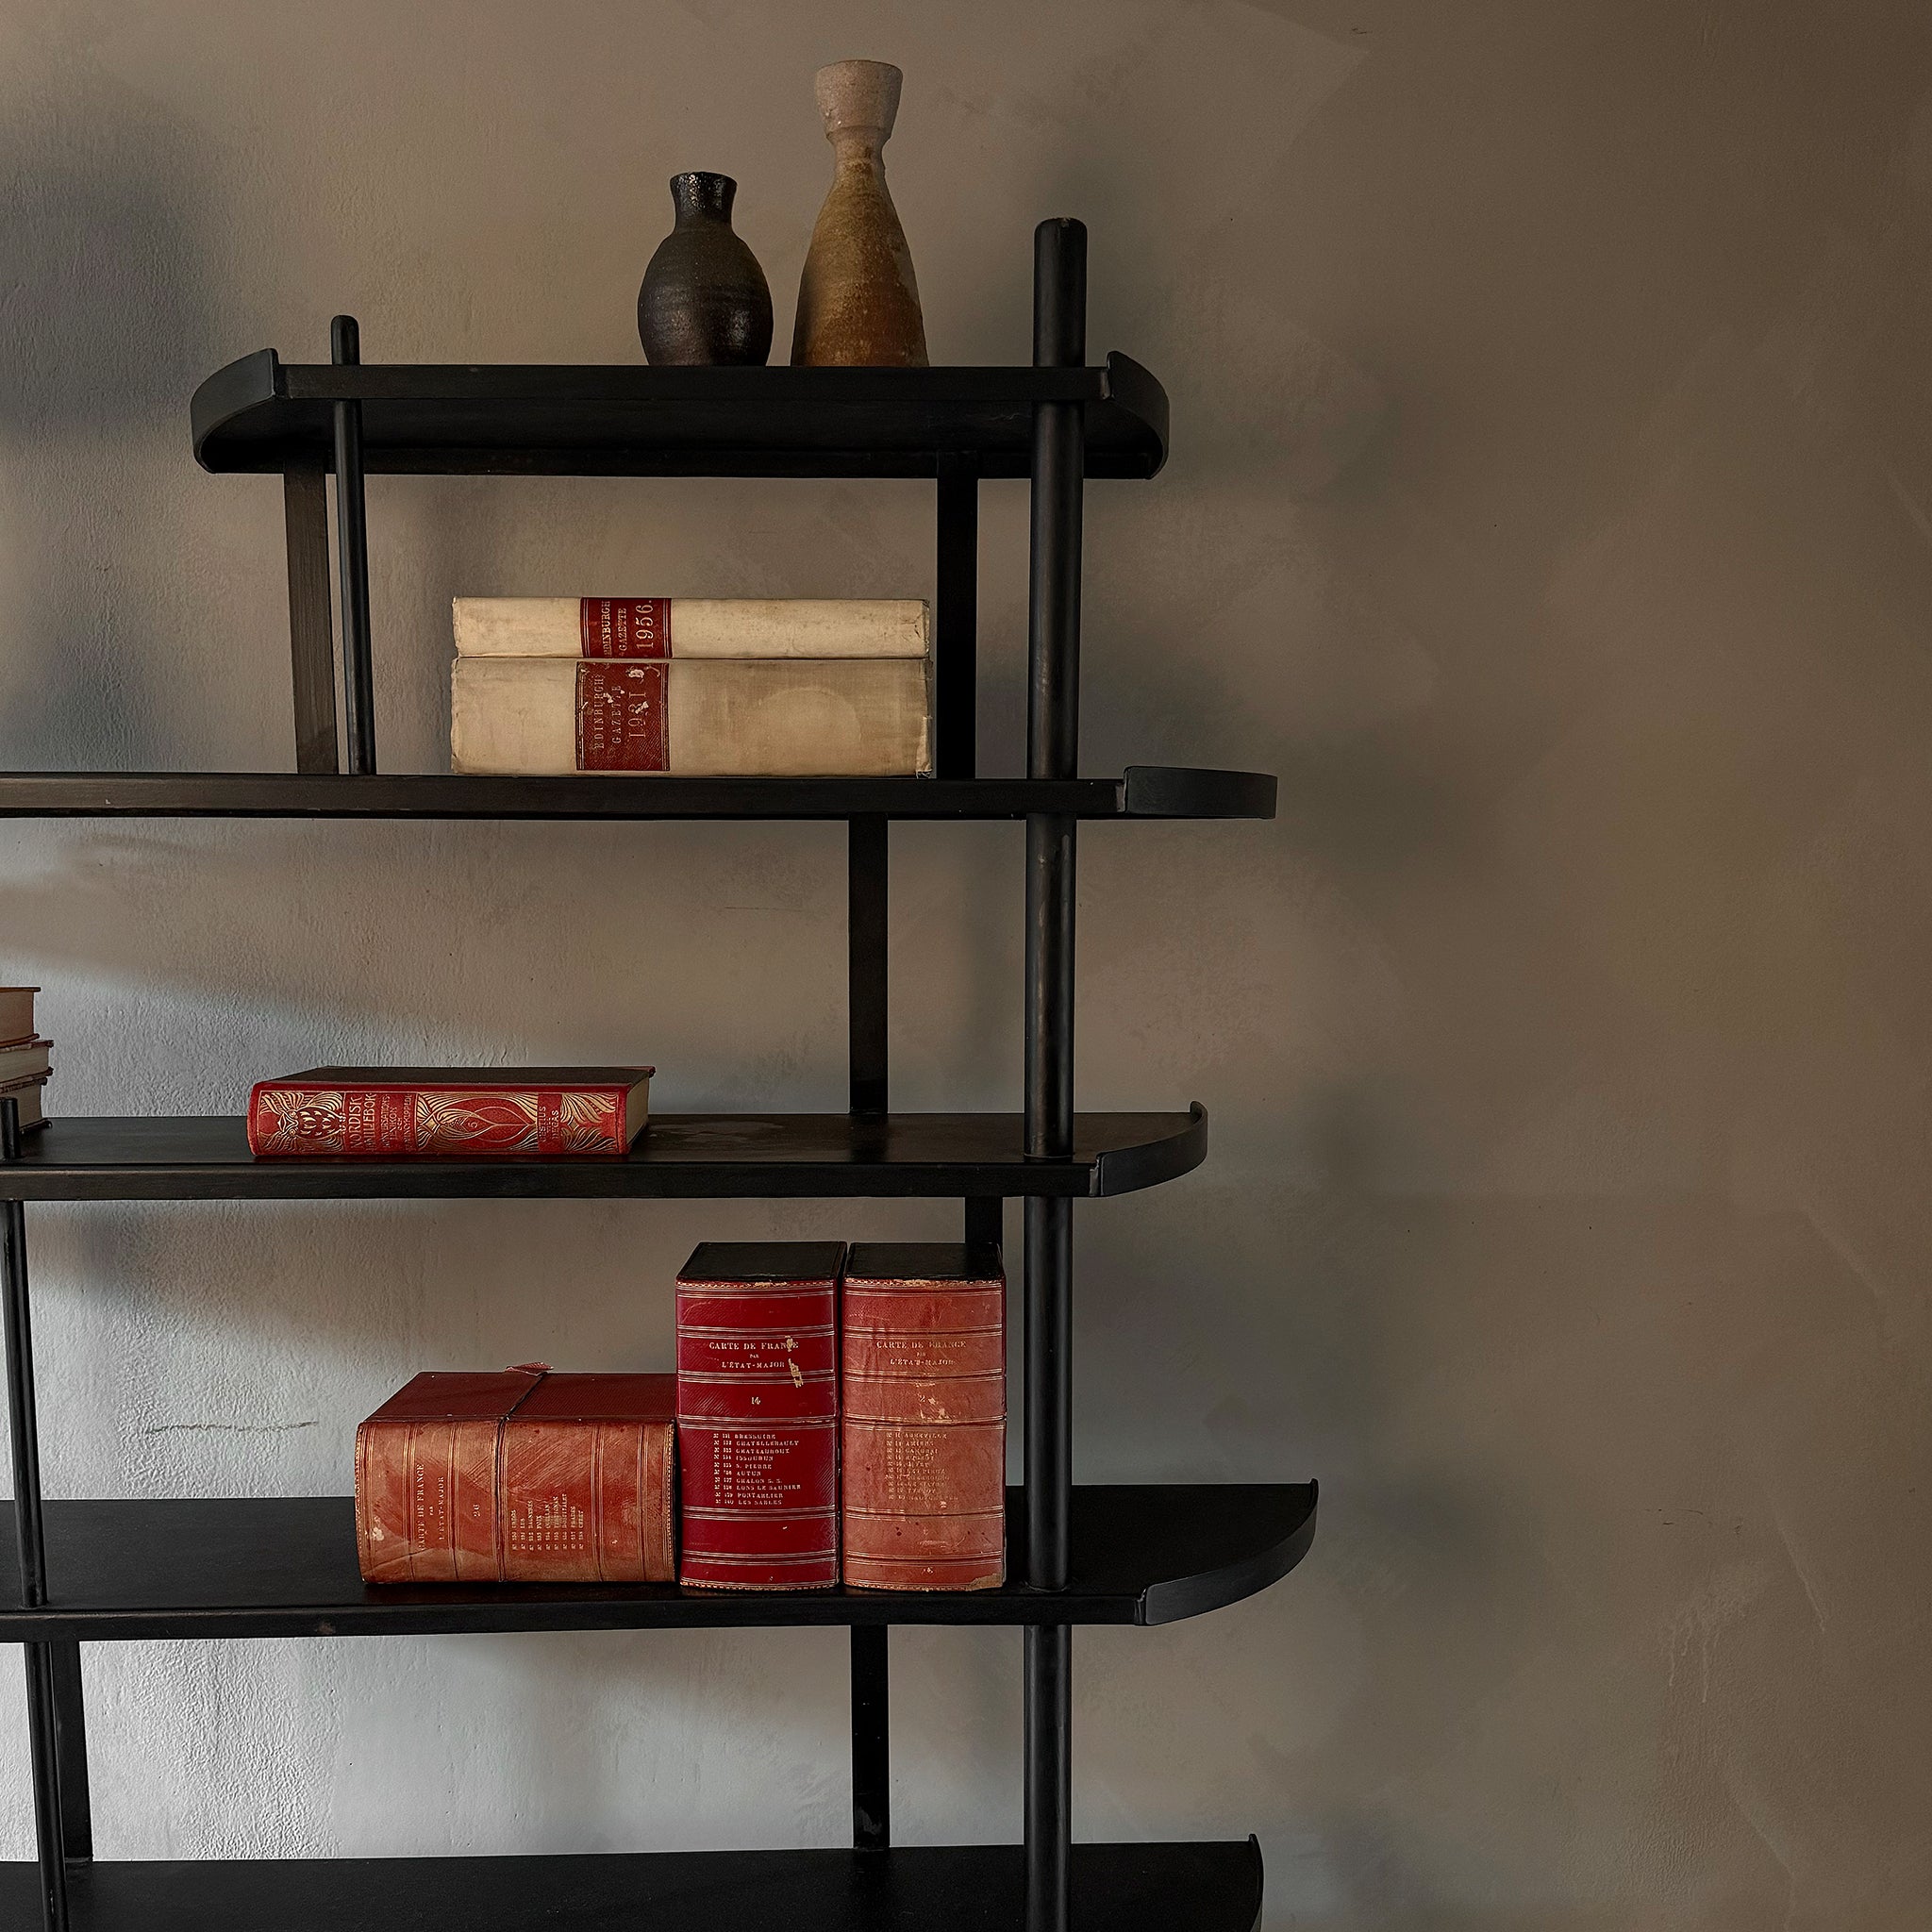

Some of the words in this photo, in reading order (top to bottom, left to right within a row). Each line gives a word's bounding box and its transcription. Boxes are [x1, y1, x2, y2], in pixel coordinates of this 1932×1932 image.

[602, 601, 611, 656] EDINBURGH
[618, 608, 626, 651] GAZETTE
[594, 676, 604, 749] EDINBURGH
[348, 1096, 362, 1149] NORDISK
[761, 1341, 799, 1350] FRANE
[416, 1464, 425, 1501] FRANCE
[417, 1505, 425, 1517] DE
